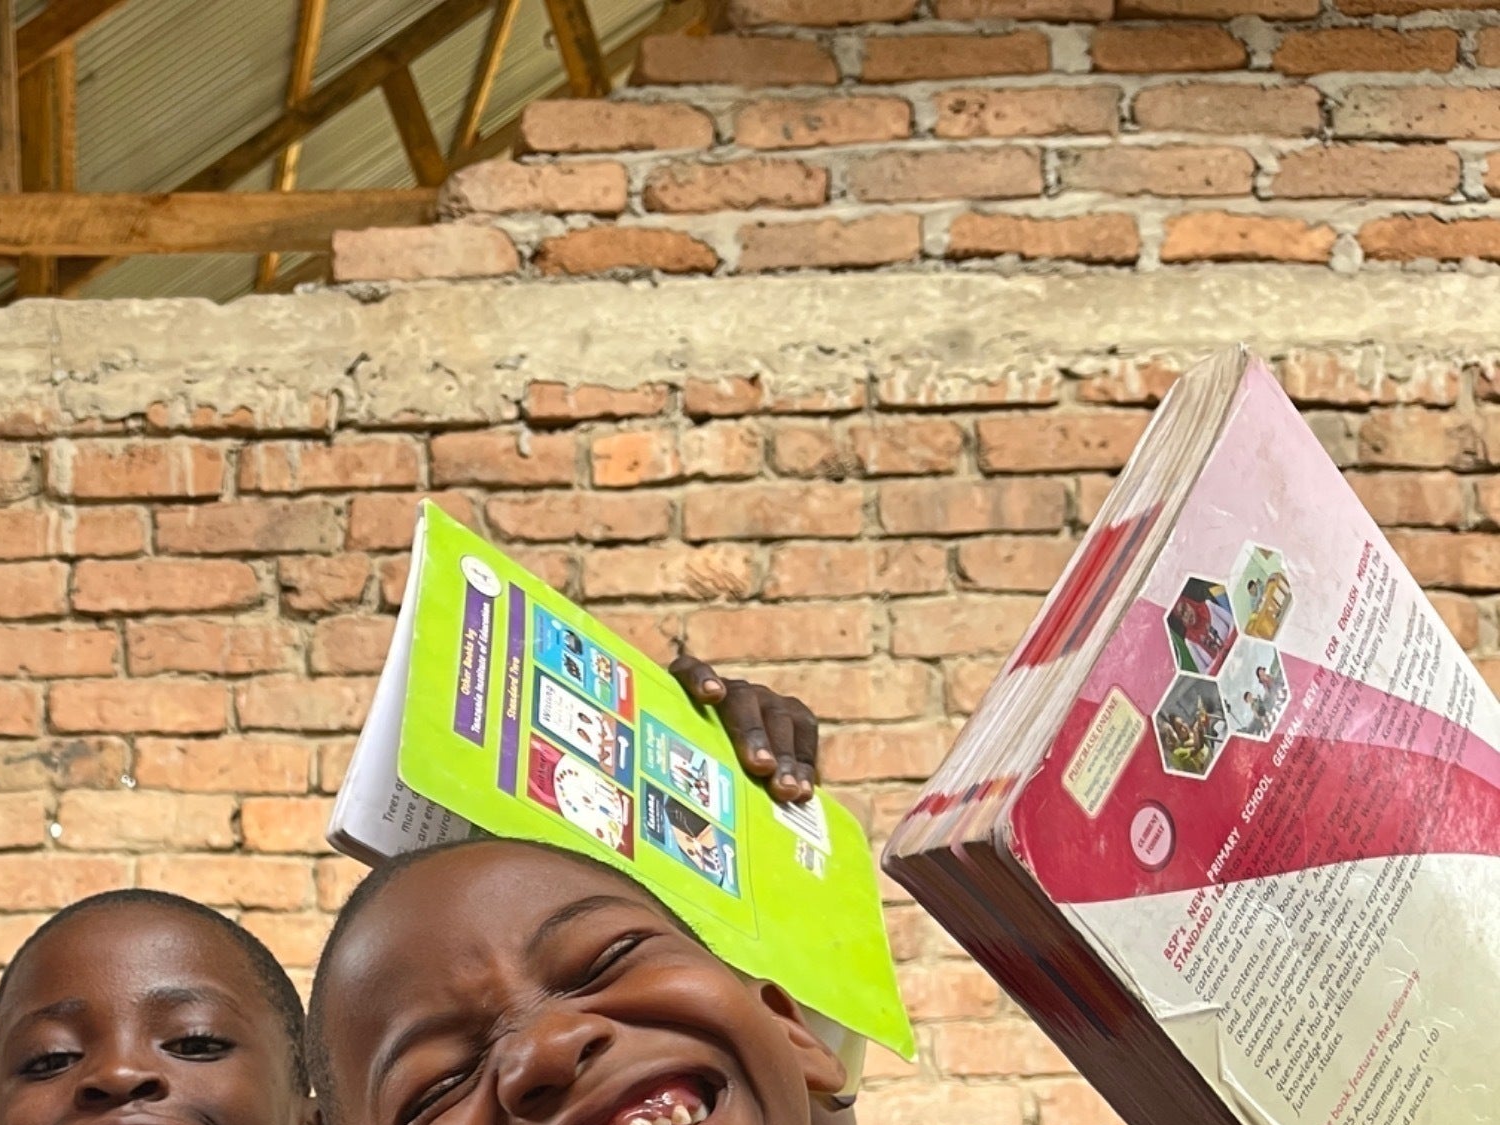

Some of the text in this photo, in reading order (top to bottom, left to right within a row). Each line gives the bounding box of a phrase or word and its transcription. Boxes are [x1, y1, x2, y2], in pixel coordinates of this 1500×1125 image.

[461, 627, 478, 696] Other Books by
[470, 602, 490, 734] Tanzania Institute of Education
[507, 656, 520, 721] Standard Two
[1068, 734, 1099, 783] PURCHASE
[1096, 697, 1119, 733] ONLINE
[1163, 925, 1187, 961] BSP's
[1186, 891, 1206, 920] NEW
[1206, 826, 1240, 883] PRIMARY
[1241, 774, 1274, 824] SCHOOL
[1272, 716, 1302, 768] GENERAL
[1301, 661, 1326, 711] REVIEW
[1325, 635, 1340, 661] FOR
[1337, 584, 1359, 632] ENGLISH
[382, 793, 400, 823] Trees
[401, 801, 417, 833] more
[417, 821, 430, 842] are
[1173, 905, 1213, 973] STANDARD
[1183, 882, 1245, 984] book prepare them
[1194, 955, 1219, 996] carters
[1216, 935, 1230, 955] the
[1228, 887, 1257, 936] contents
[1255, 871, 1264, 888] of
[1202, 880, 1279, 1003] Science and Technology
[1215, 885, 1297, 1021] The contents in this book
[1245, 994, 1282, 1058] assessment
[1280, 958, 1303, 998] papers
[1319, 897, 1338, 927] while
[1267, 937, 1299, 988] Listening
[1299, 908, 1314, 934] and
[1227, 1008, 1242, 1035] and
[1254, 933, 1333, 1068] comprise 125 assessment
[1265, 909, 1367, 1080] The review of each subject is
[1276, 892, 1391, 1092] questions that will enable learners to
[1282, 880, 1413, 1103] knowledge and skills not only for passing
[1330, 1091, 1352, 1120] book
[1348, 1043, 1379, 1094] features
[1375, 1023, 1390, 1043] the
[1387, 970, 1420, 1027] following:
[1353, 1054, 1392, 1118] Assessment
[1388, 1019, 1411, 1055] Papers
[1403, 1063, 1422, 1092] table
[1419, 1027, 1440, 1063] (1-10)
[1291, 1072, 1318, 1117] further
[1366, 1065, 1403, 1125] Summaries
[1408, 1075, 1434, 1120] pictures
